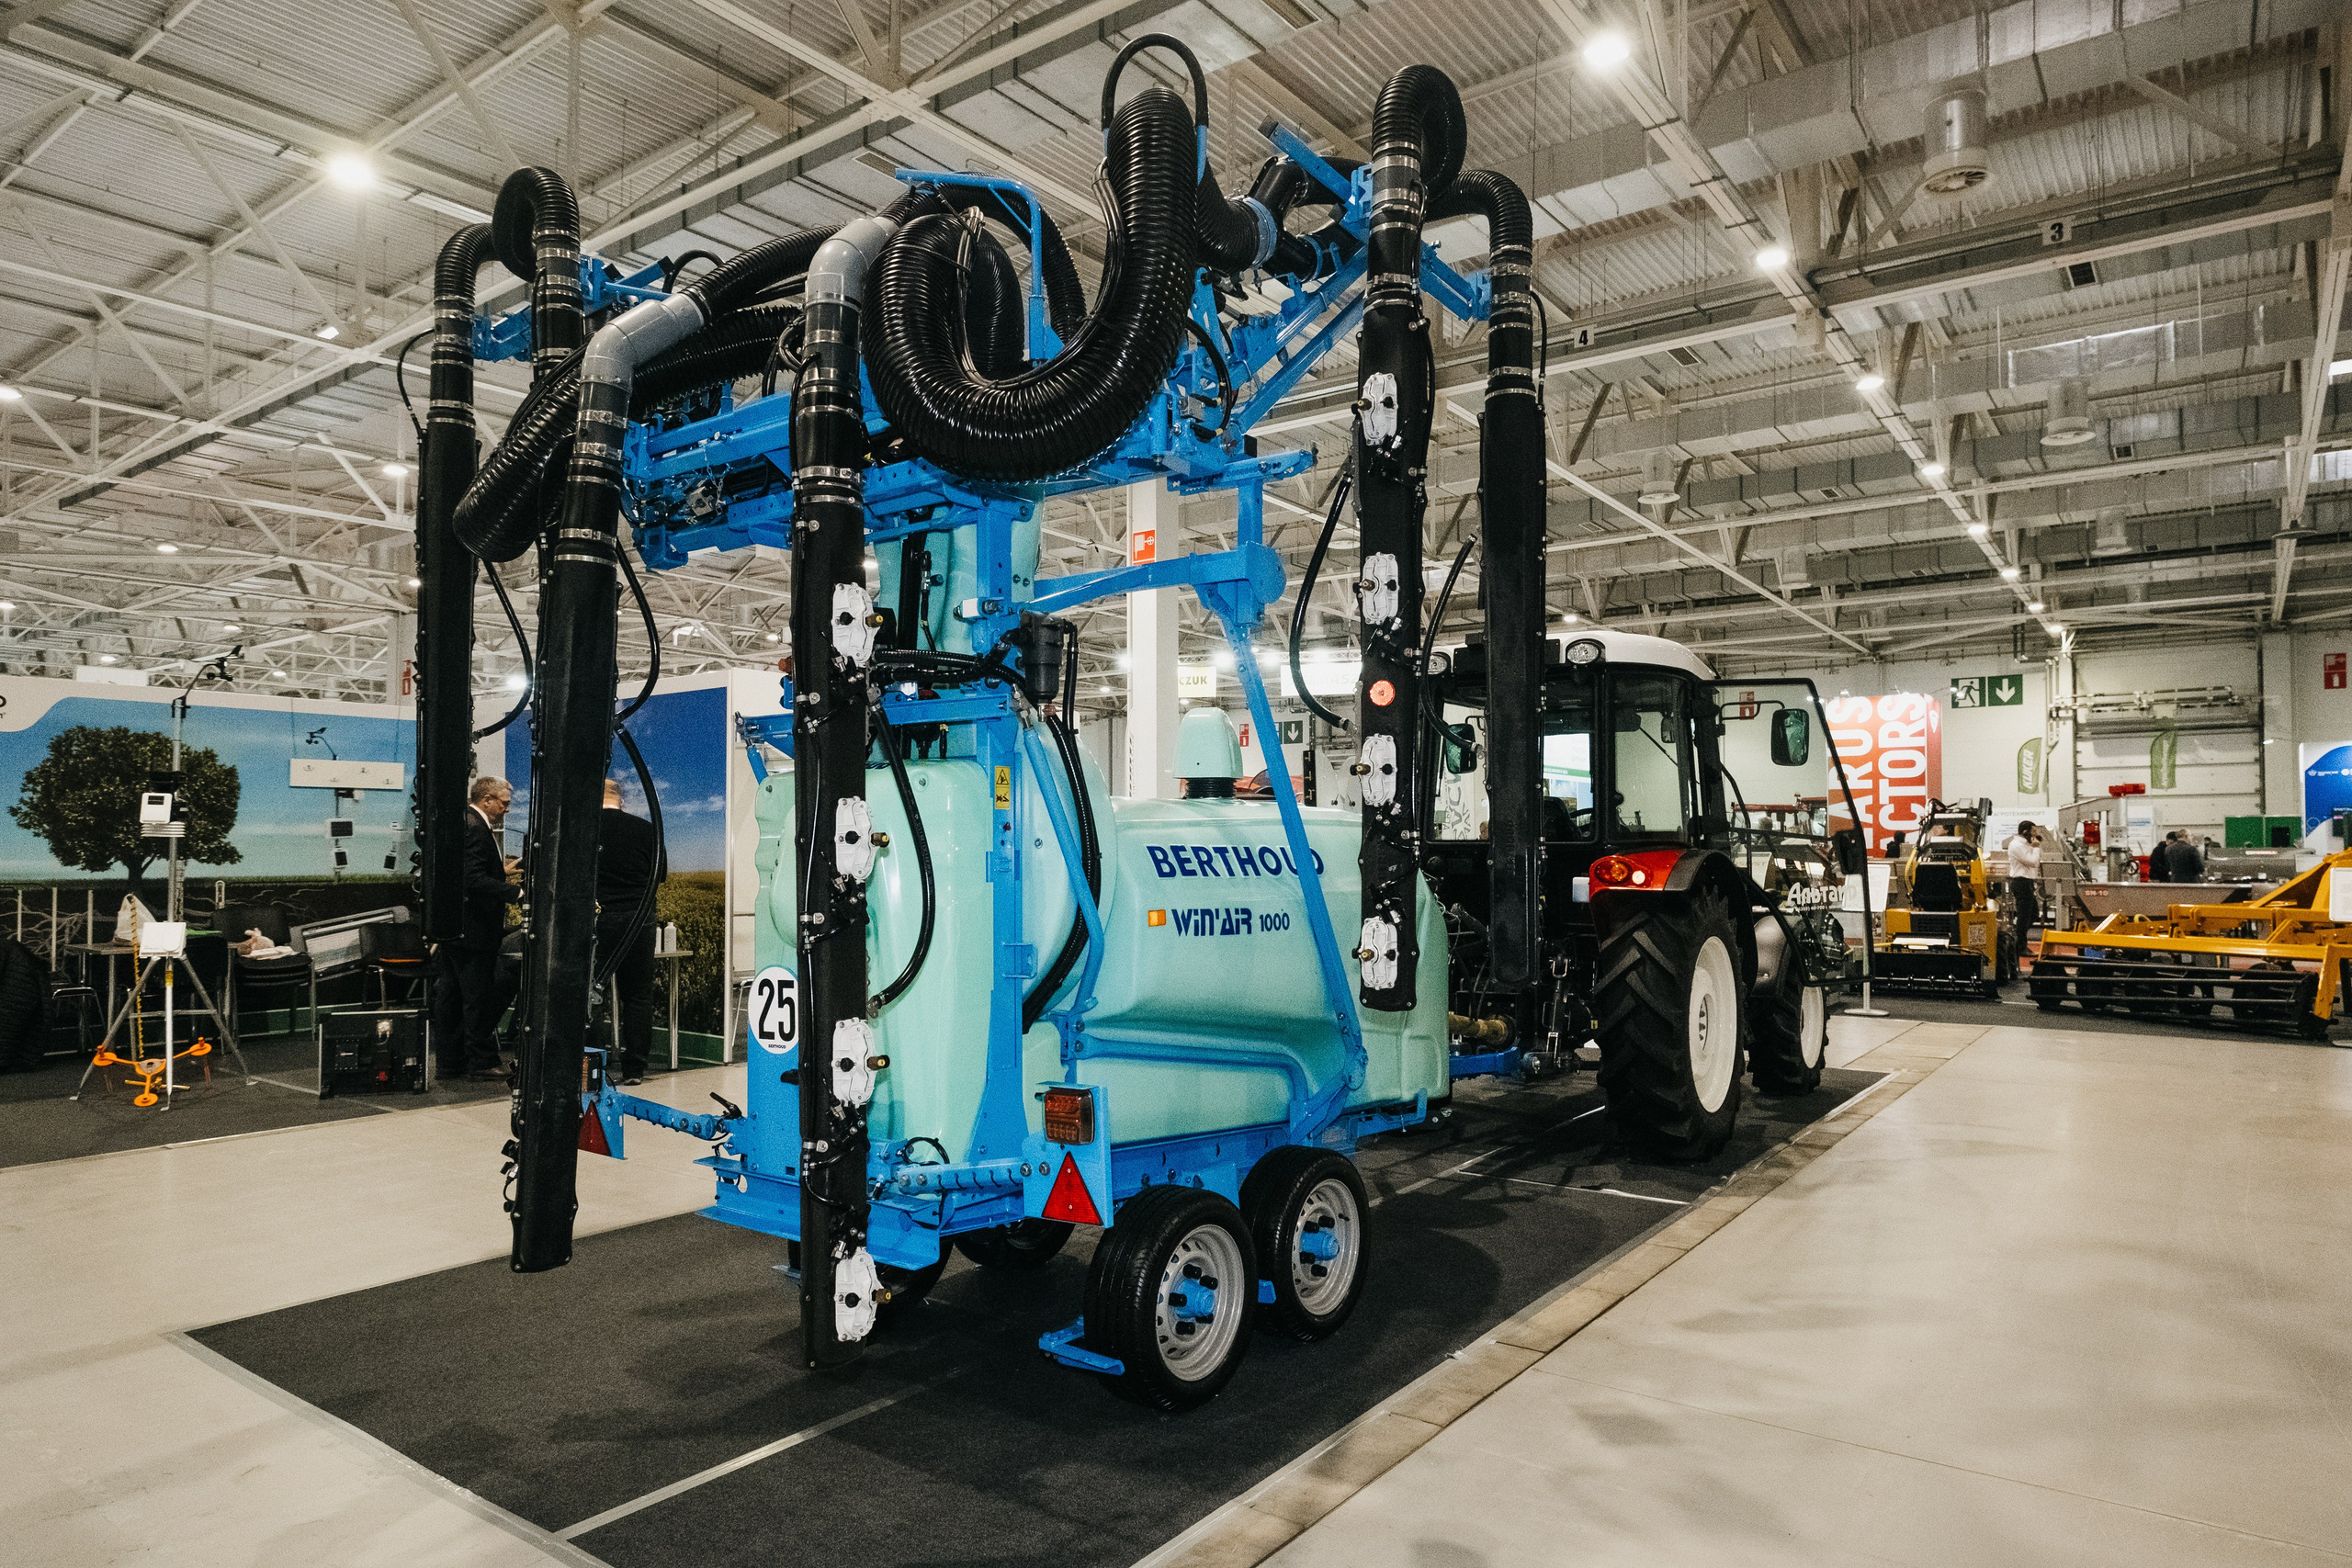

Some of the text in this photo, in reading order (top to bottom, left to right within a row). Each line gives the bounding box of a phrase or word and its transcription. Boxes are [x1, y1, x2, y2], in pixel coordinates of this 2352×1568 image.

[2050, 222, 2064, 242] 3
[1578, 330, 1589, 345] 4
[1825, 695, 1874, 850] ARUS
[2022, 748, 2034, 790] KUKER
[1259, 912, 1291, 932] 1000
[757, 977, 797, 1043] 25
